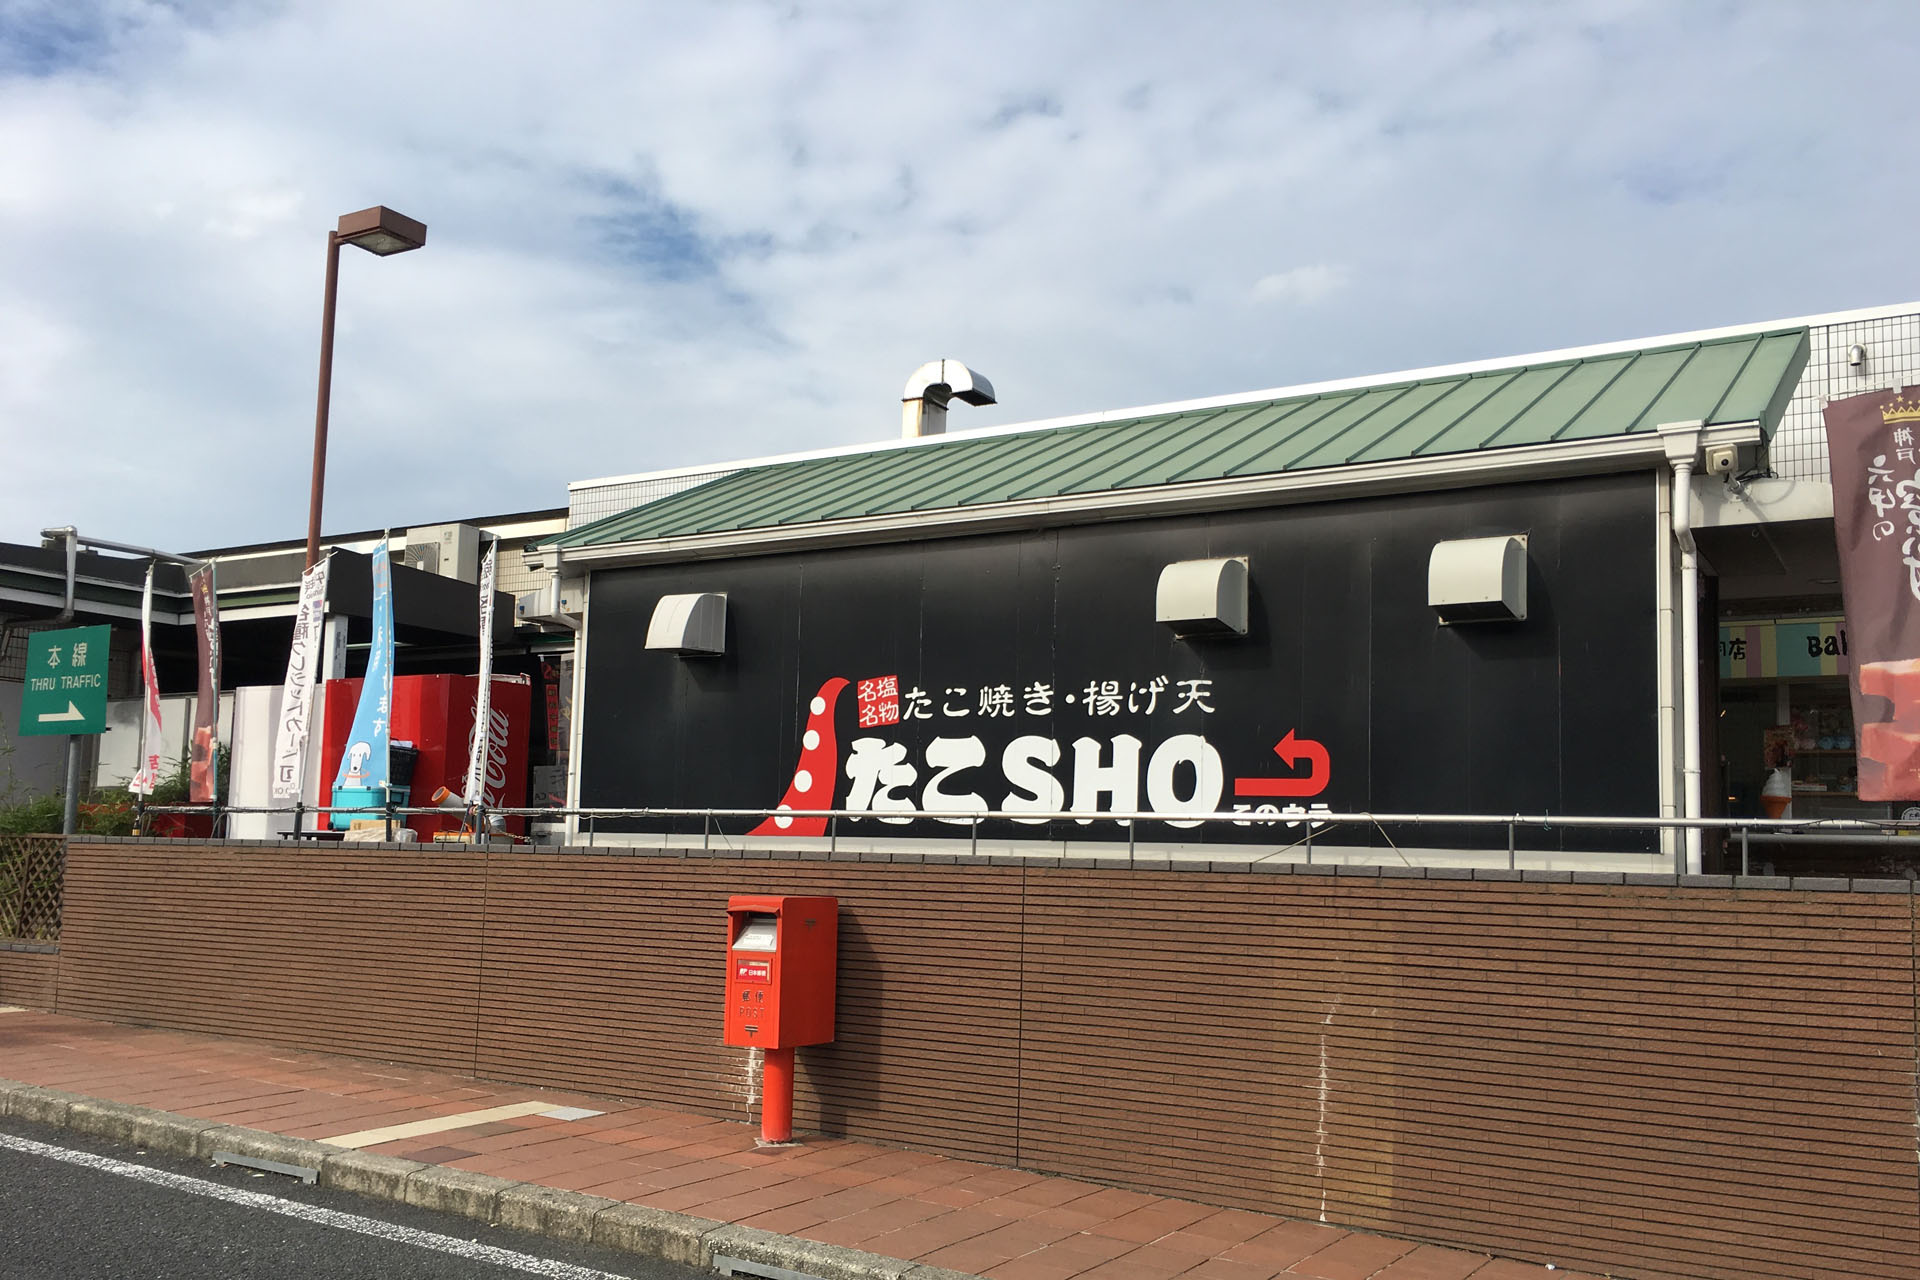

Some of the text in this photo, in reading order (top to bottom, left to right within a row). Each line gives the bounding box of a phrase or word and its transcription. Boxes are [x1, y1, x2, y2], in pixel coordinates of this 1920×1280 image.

[48, 642, 87, 669] 本線
[31, 674, 101, 691] THRU TRAFFIC
[858, 677, 898, 702] 名塩
[903, 675, 1215, 720] たこ焼き・揚げ天
[859, 702, 899, 726] 名物
[845, 734, 1224, 828] たこSHO
[739, 1006, 765, 1019] POST
